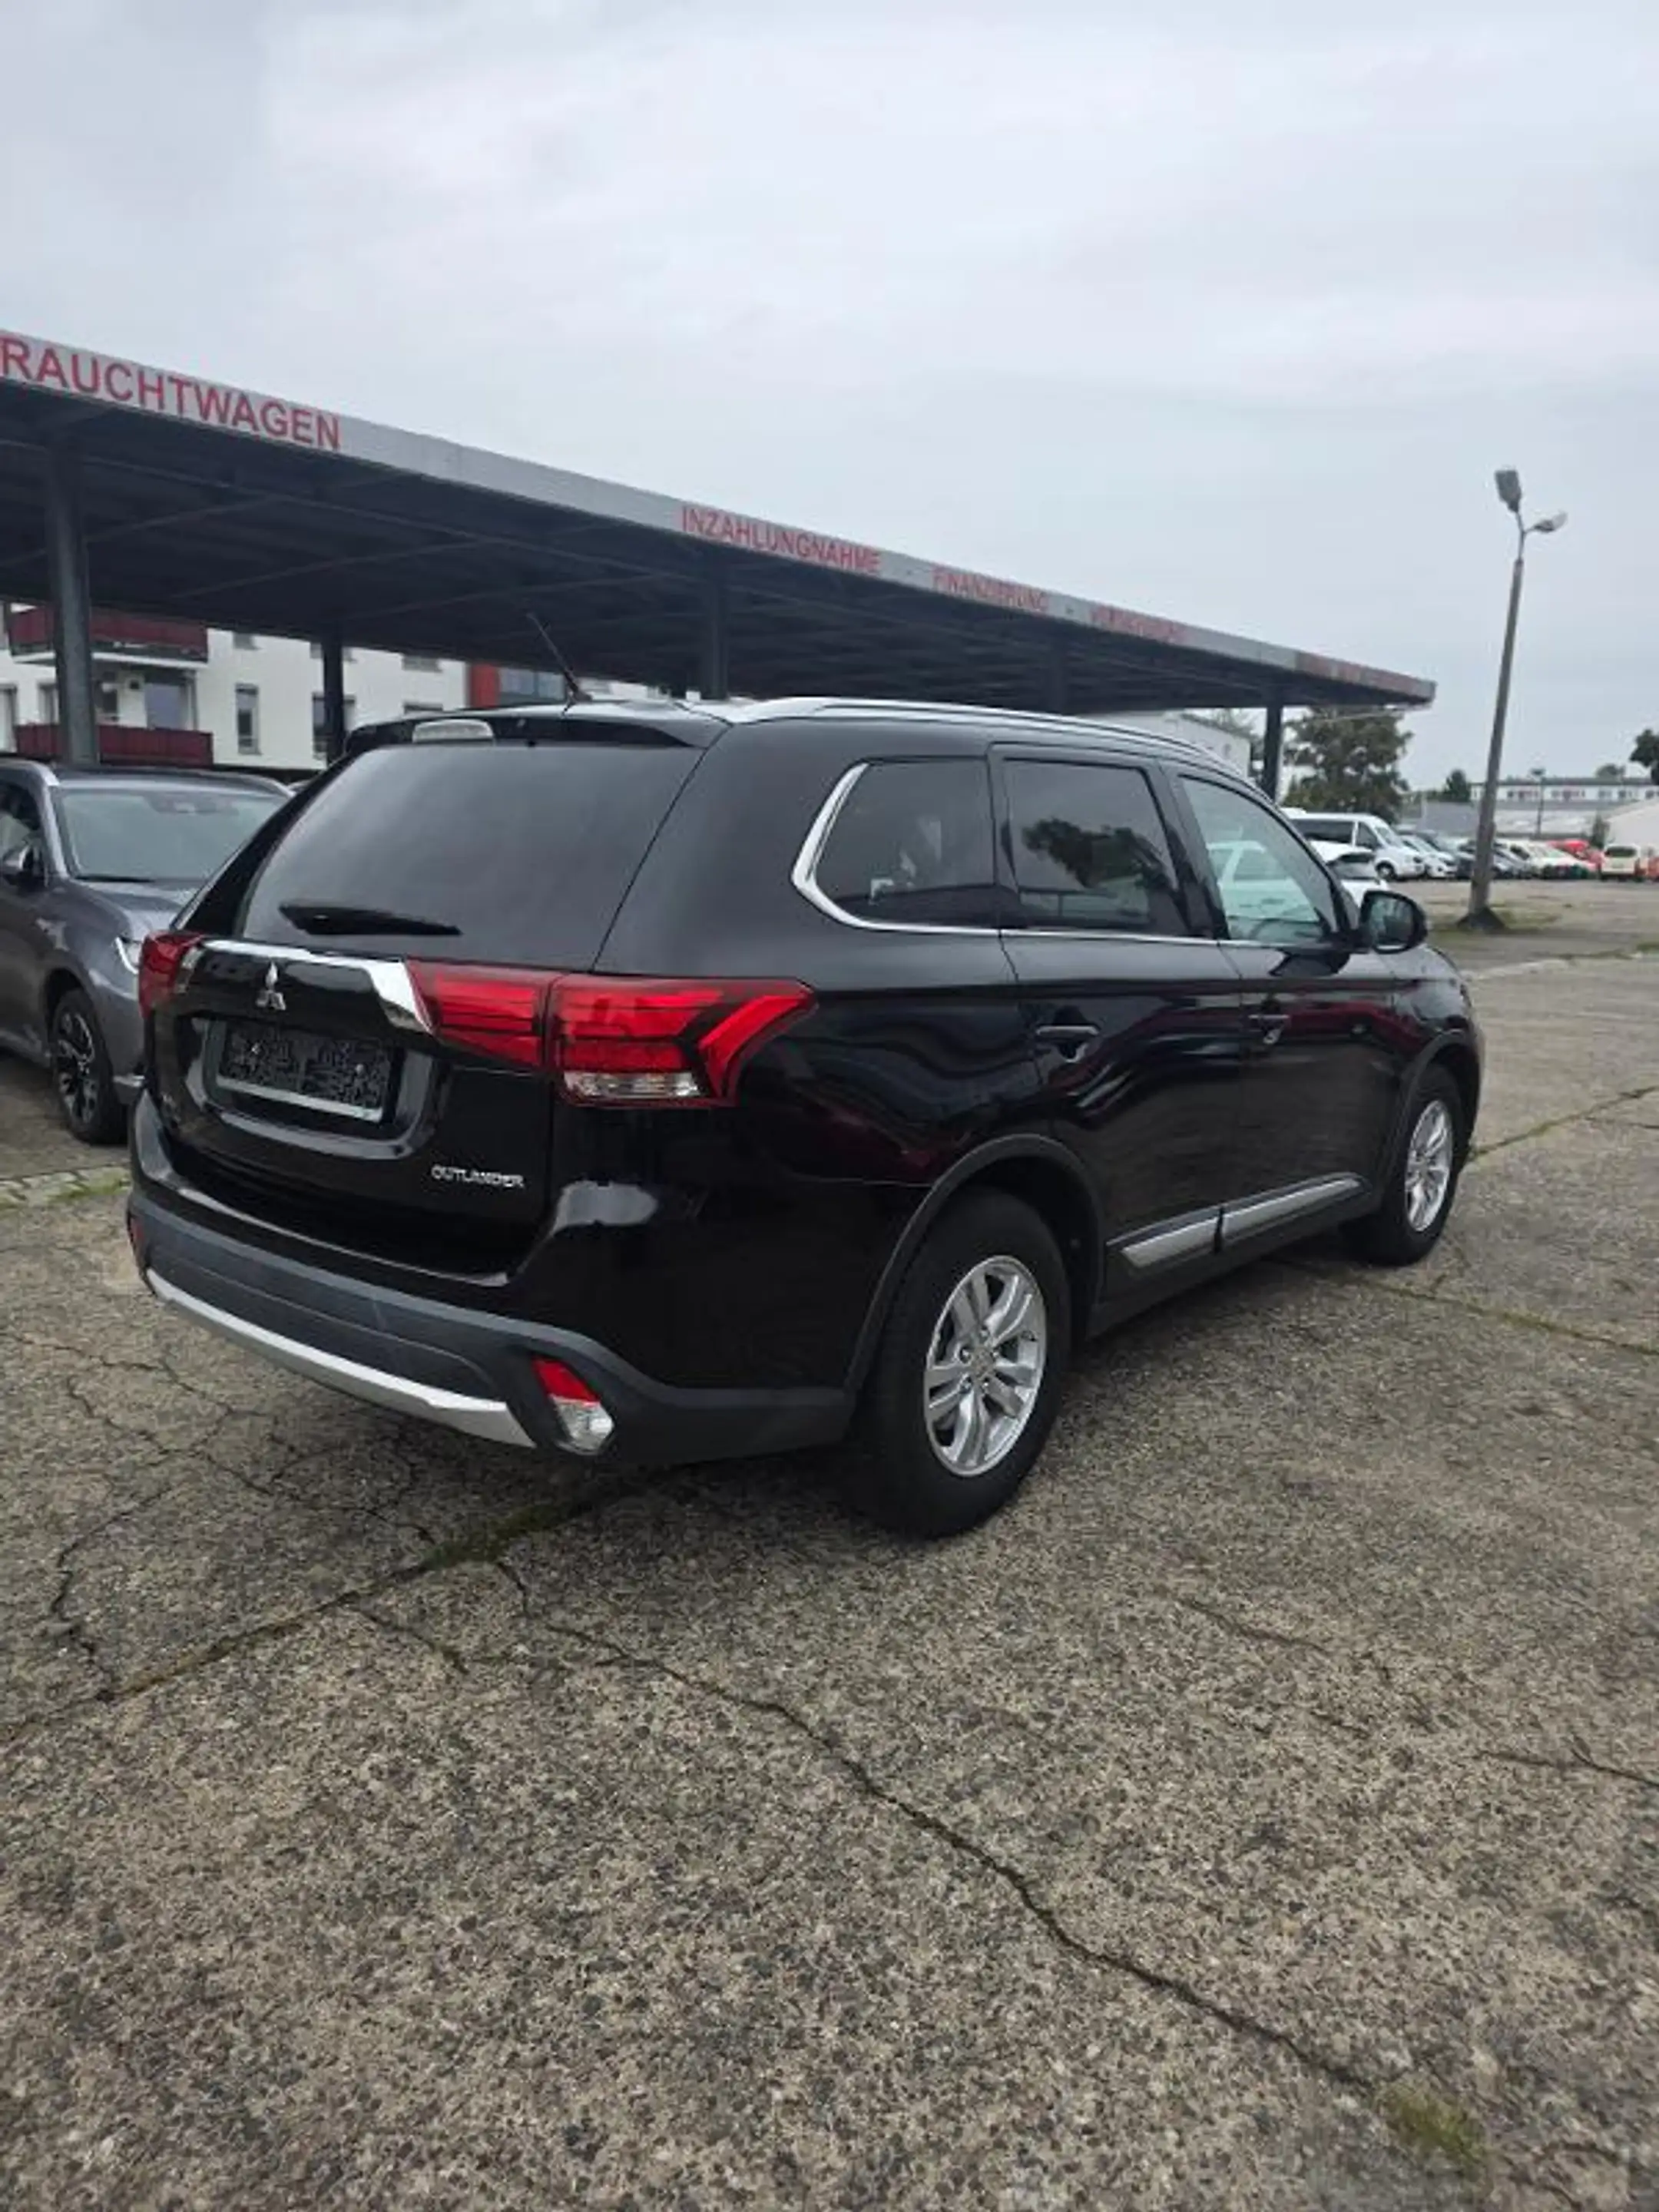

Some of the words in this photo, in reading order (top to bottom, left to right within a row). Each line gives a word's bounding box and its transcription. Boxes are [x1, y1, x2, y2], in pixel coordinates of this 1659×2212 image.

[0, 335, 341, 450] RAUCHTWAGEN
[681, 505, 882, 575] INZAHLUNGNAHME
[431, 1164, 525, 1187] OUTLANDER
